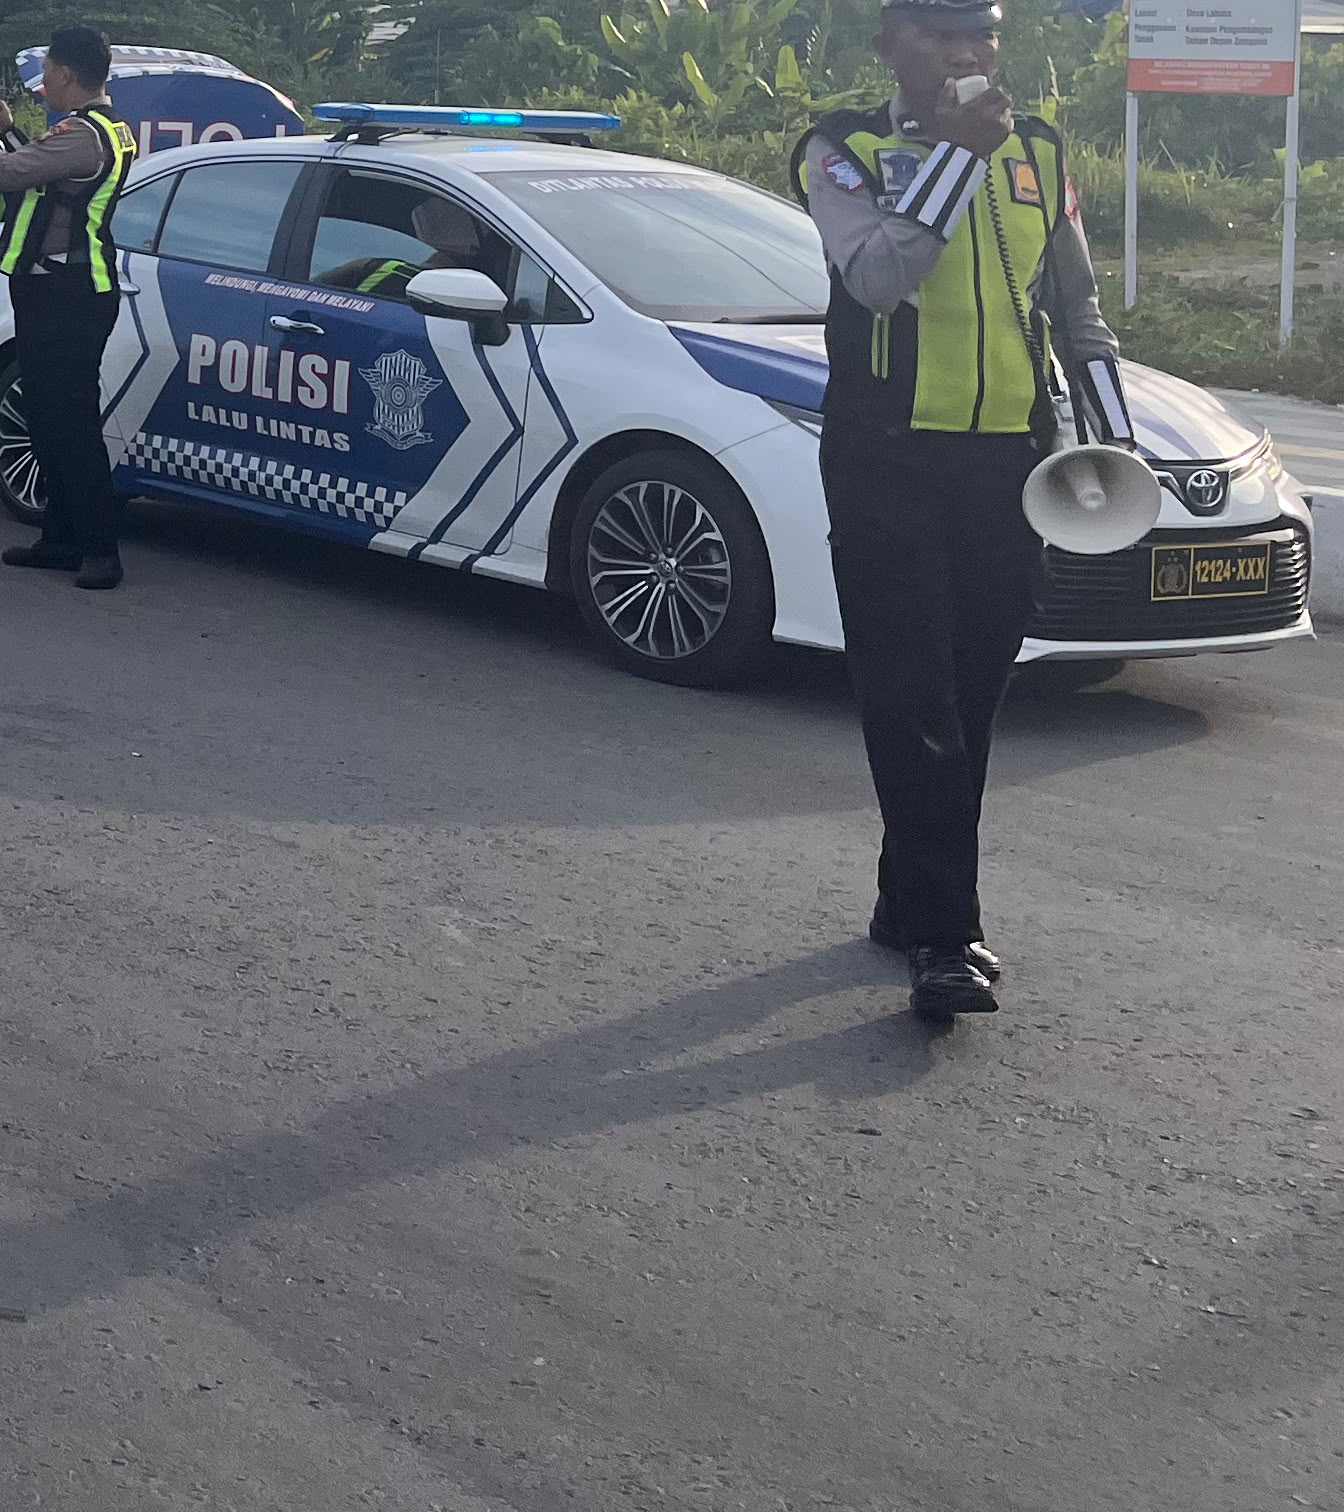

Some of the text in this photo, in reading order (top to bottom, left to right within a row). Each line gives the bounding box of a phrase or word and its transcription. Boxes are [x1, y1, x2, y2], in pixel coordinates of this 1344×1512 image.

[528, 176, 633, 194] DITLANTAS
[187, 333, 351, 415] POLISI
[187, 401, 248, 430] LALU
[255, 415, 351, 452] LINTAS
[1195, 556, 1266, 583] 12124-XXX
